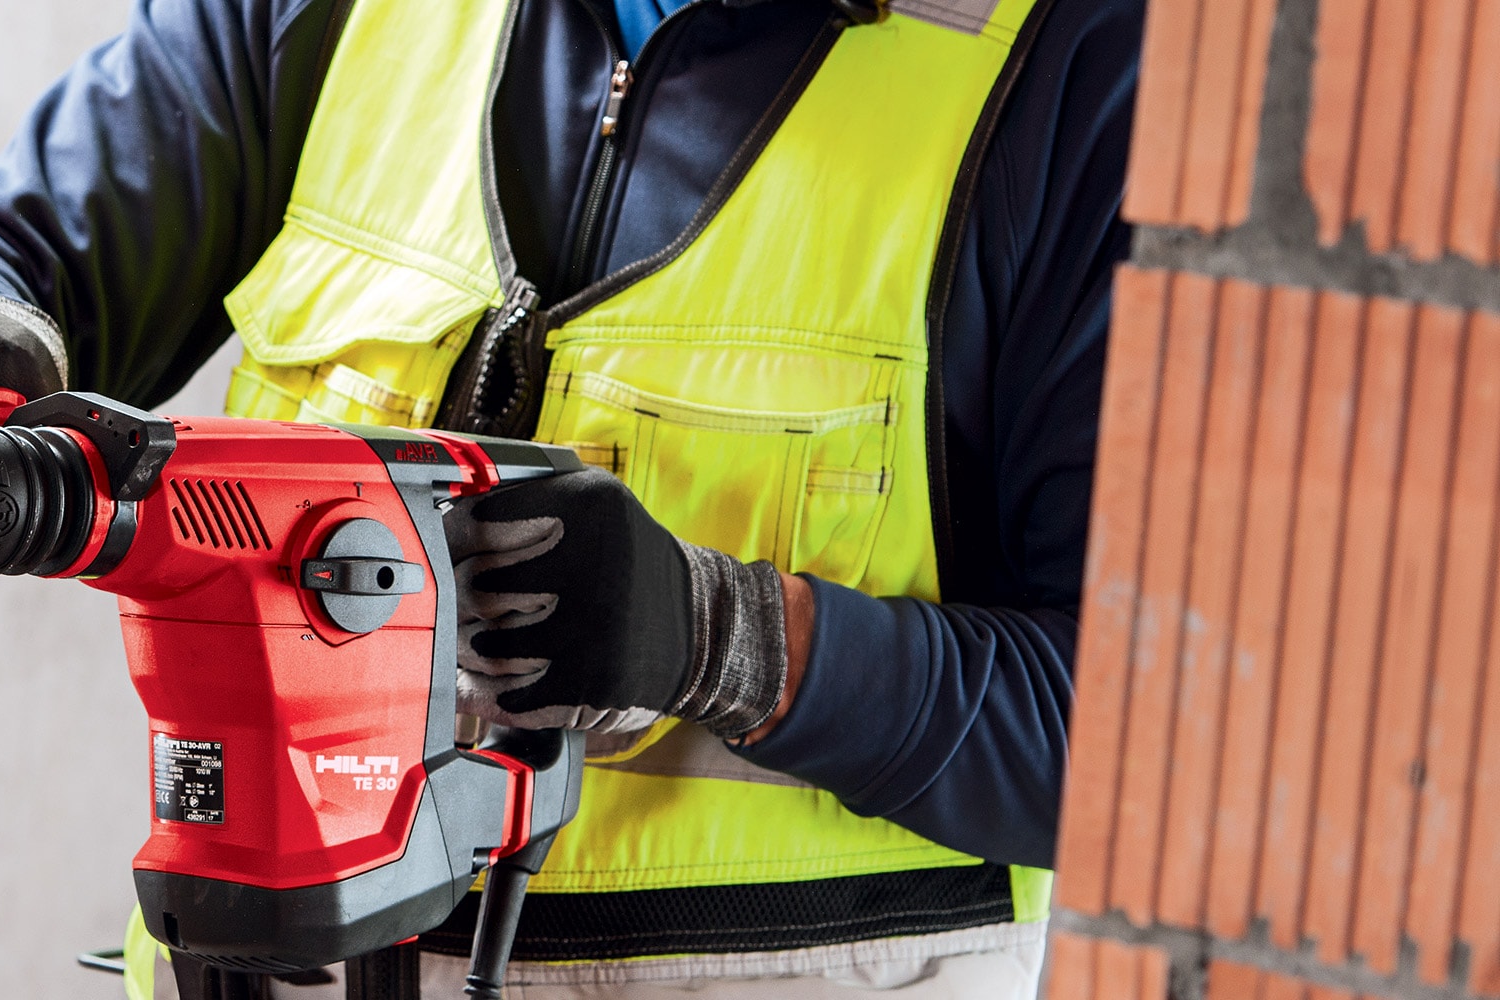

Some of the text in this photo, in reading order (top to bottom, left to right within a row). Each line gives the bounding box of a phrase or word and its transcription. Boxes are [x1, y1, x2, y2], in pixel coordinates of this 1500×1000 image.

[405, 442, 437, 459] AVR
[316, 755, 398, 774] HILTI
[353, 777, 397, 790] TE 30
